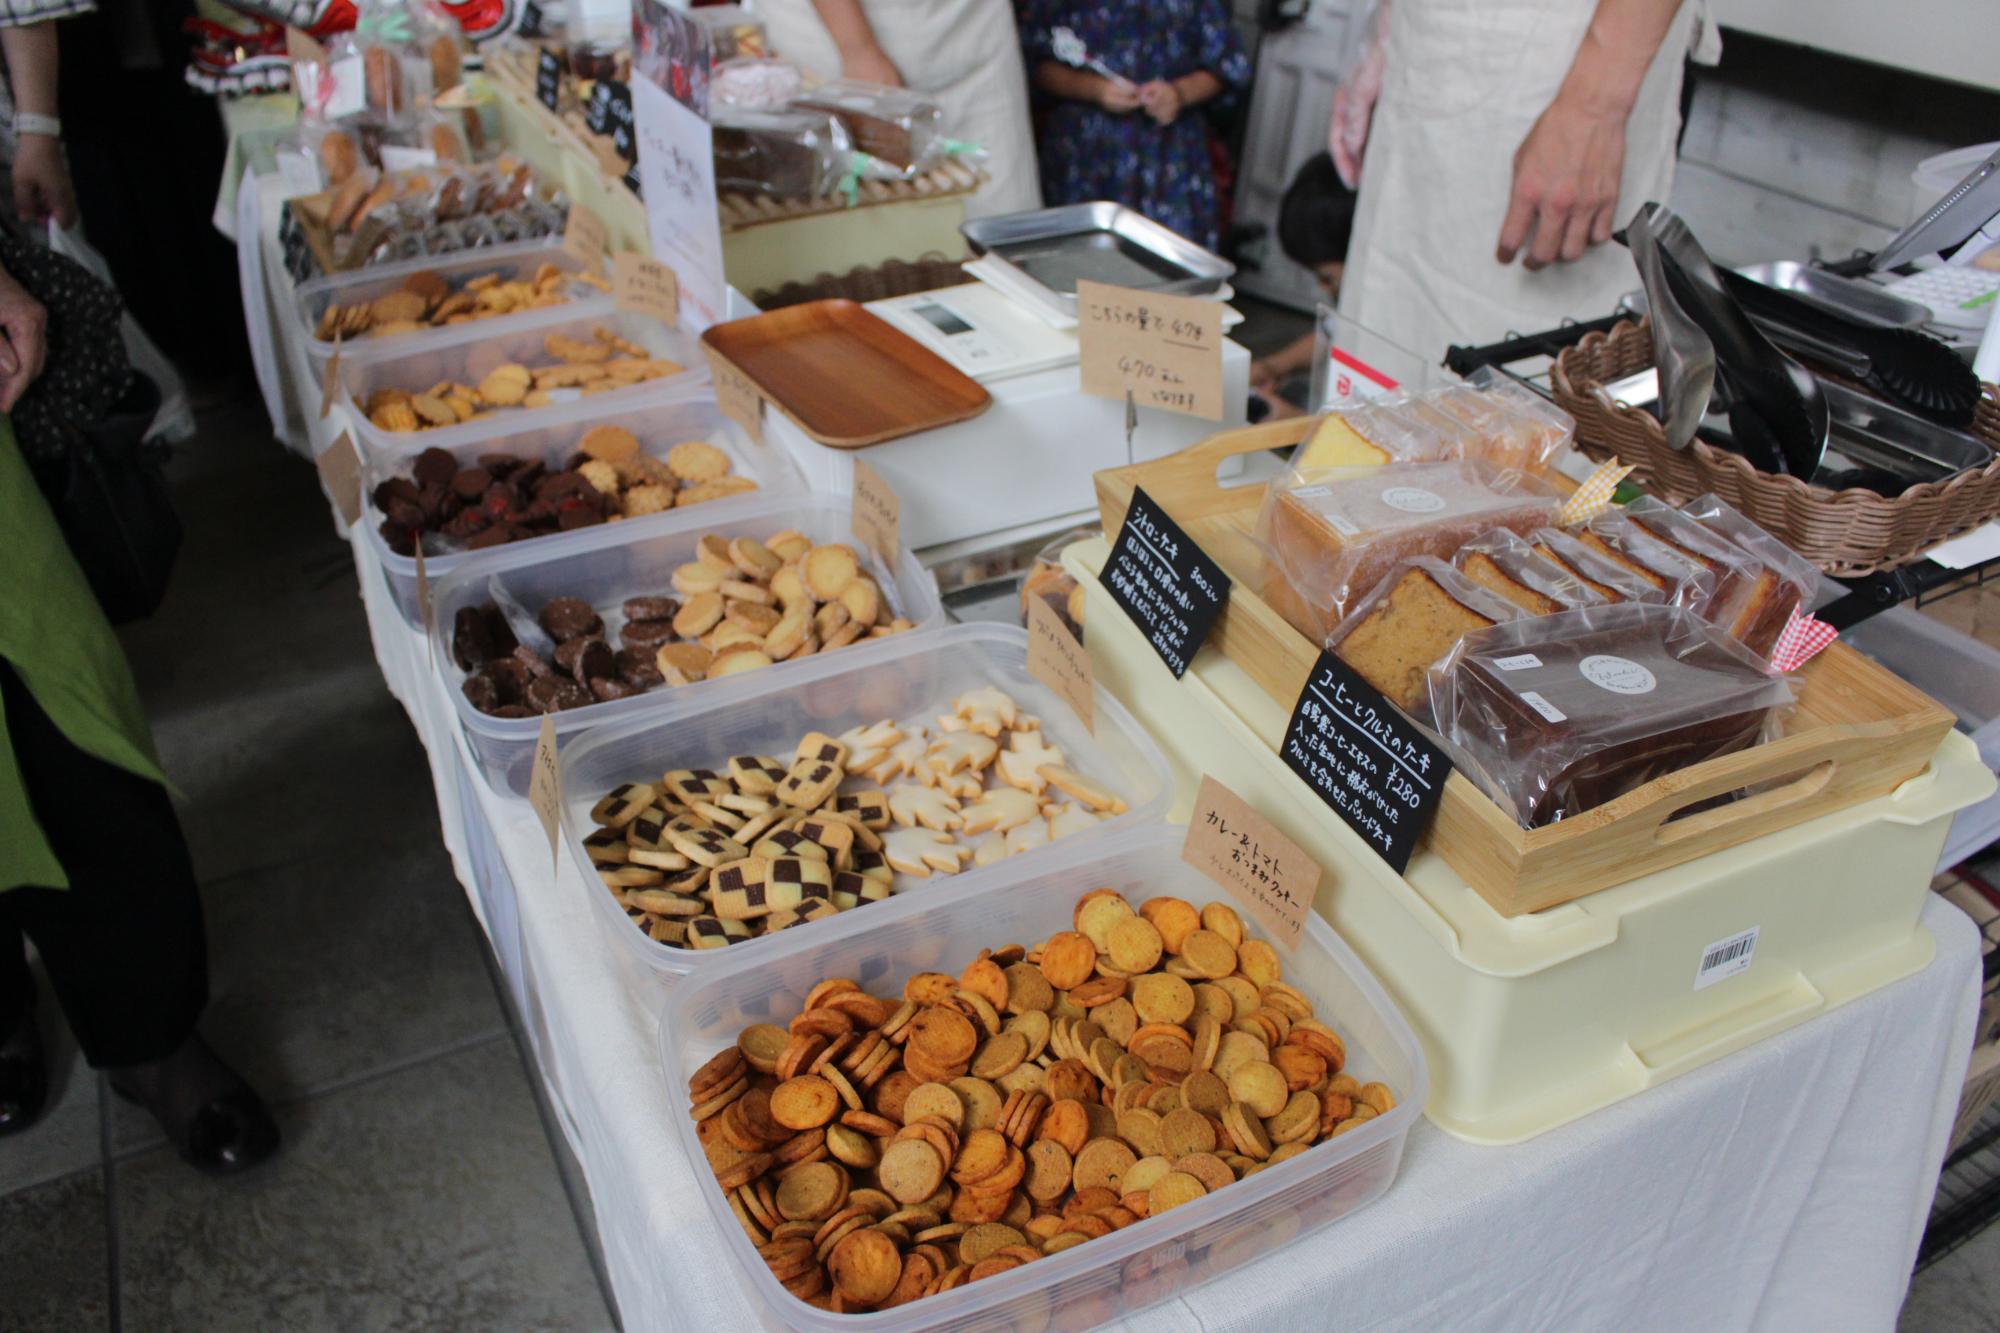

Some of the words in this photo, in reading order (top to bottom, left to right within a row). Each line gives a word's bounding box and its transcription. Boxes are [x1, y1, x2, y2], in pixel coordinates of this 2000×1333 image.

[1318, 669, 1432, 774] コーヒーとクルミのケーキ
[1385, 762, 1421, 809] ¥280
[1206, 810, 1284, 877] カレー&トマト
[1231, 848, 1300, 909] おつまみクッキー
